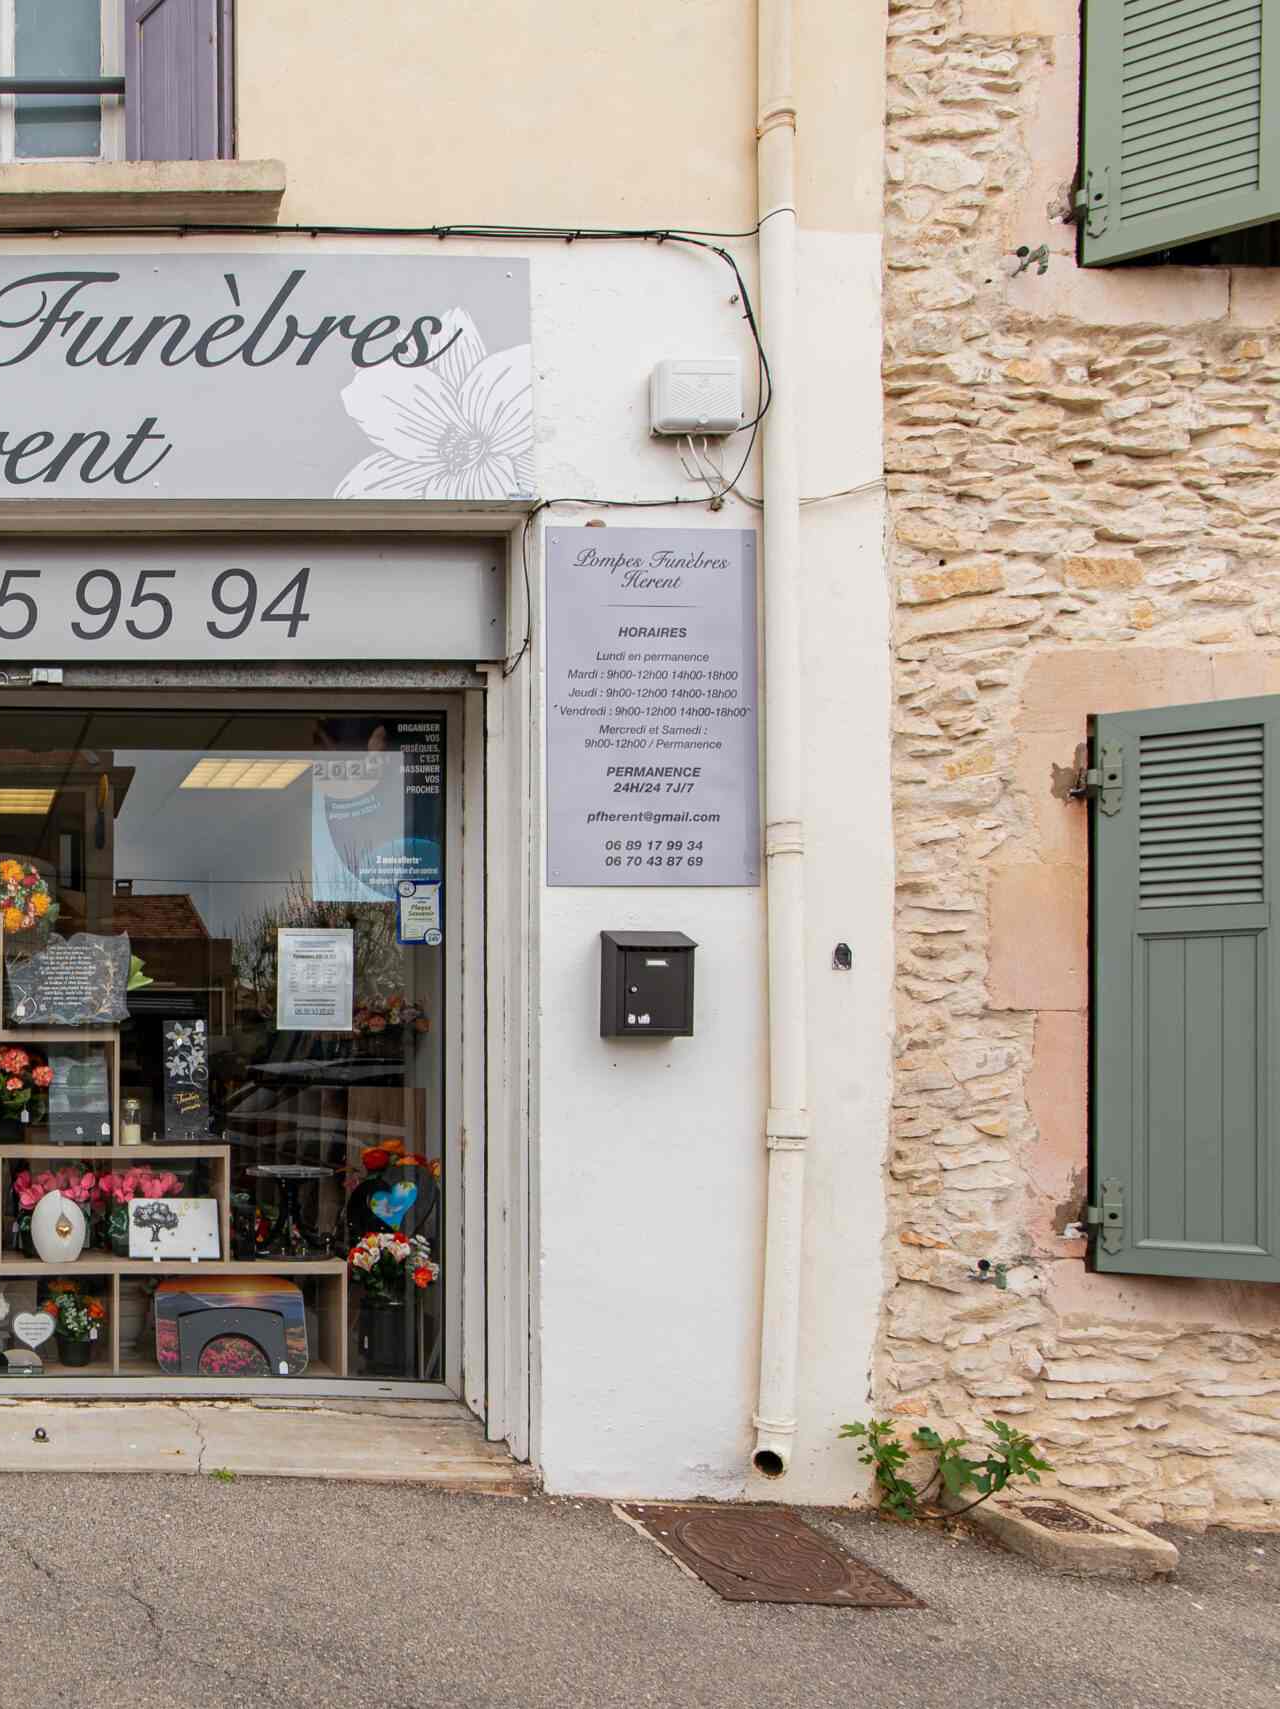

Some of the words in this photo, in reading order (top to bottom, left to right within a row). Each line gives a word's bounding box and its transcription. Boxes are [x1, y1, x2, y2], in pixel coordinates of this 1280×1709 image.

[572, 547, 643, 573] Pompes
[649, 549, 730, 570] Funèbres
[620, 570, 682, 589] Herent
[71, 568, 176, 641] 95
[207, 567, 311, 640] 94
[617, 626, 688, 639] HORAIRES
[595, 650, 626, 662] Lundi
[627, 653, 642, 662] en
[643, 653, 710, 665] permanence
[567, 668, 599, 681] Mardi
[606, 669, 669, 681] 9h00-12h00
[671, 669, 739, 681] 14h00-18h00
[568, 687, 598, 698] Jeudi
[605, 687, 668, 699] 9h00-12h00
[670, 687, 738, 699] 14h00-18h00
[559, 705, 607, 717] Vendredi
[614, 706, 677, 717] 9h00-12h00
[680, 706, 748, 717] 14h00-18h00
[598, 724, 647, 736] Mercredi
[648, 725, 660, 736] et
[661, 724, 703, 736] Samedi
[584, 738, 647, 749] 9h00-12h00
[655, 738, 723, 750] Permanence
[606, 766, 702, 778] PERMANENCE
[612, 781, 661, 793] 24H/24
[665, 782, 695, 794] 7J/7
[586, 810, 721, 825] pfherent@gmail.com
[604, 839, 622, 851] 06
[624, 839, 643, 852] 89
[647, 839, 663, 851] 17
[666, 840, 684, 852] 99
[686, 840, 704, 852] 34
[604, 856, 622, 867] 06
[626, 856, 643, 867] 70
[645, 856, 663, 867] 43
[665, 856, 684, 867] 87
[686, 856, 704, 867] 69
